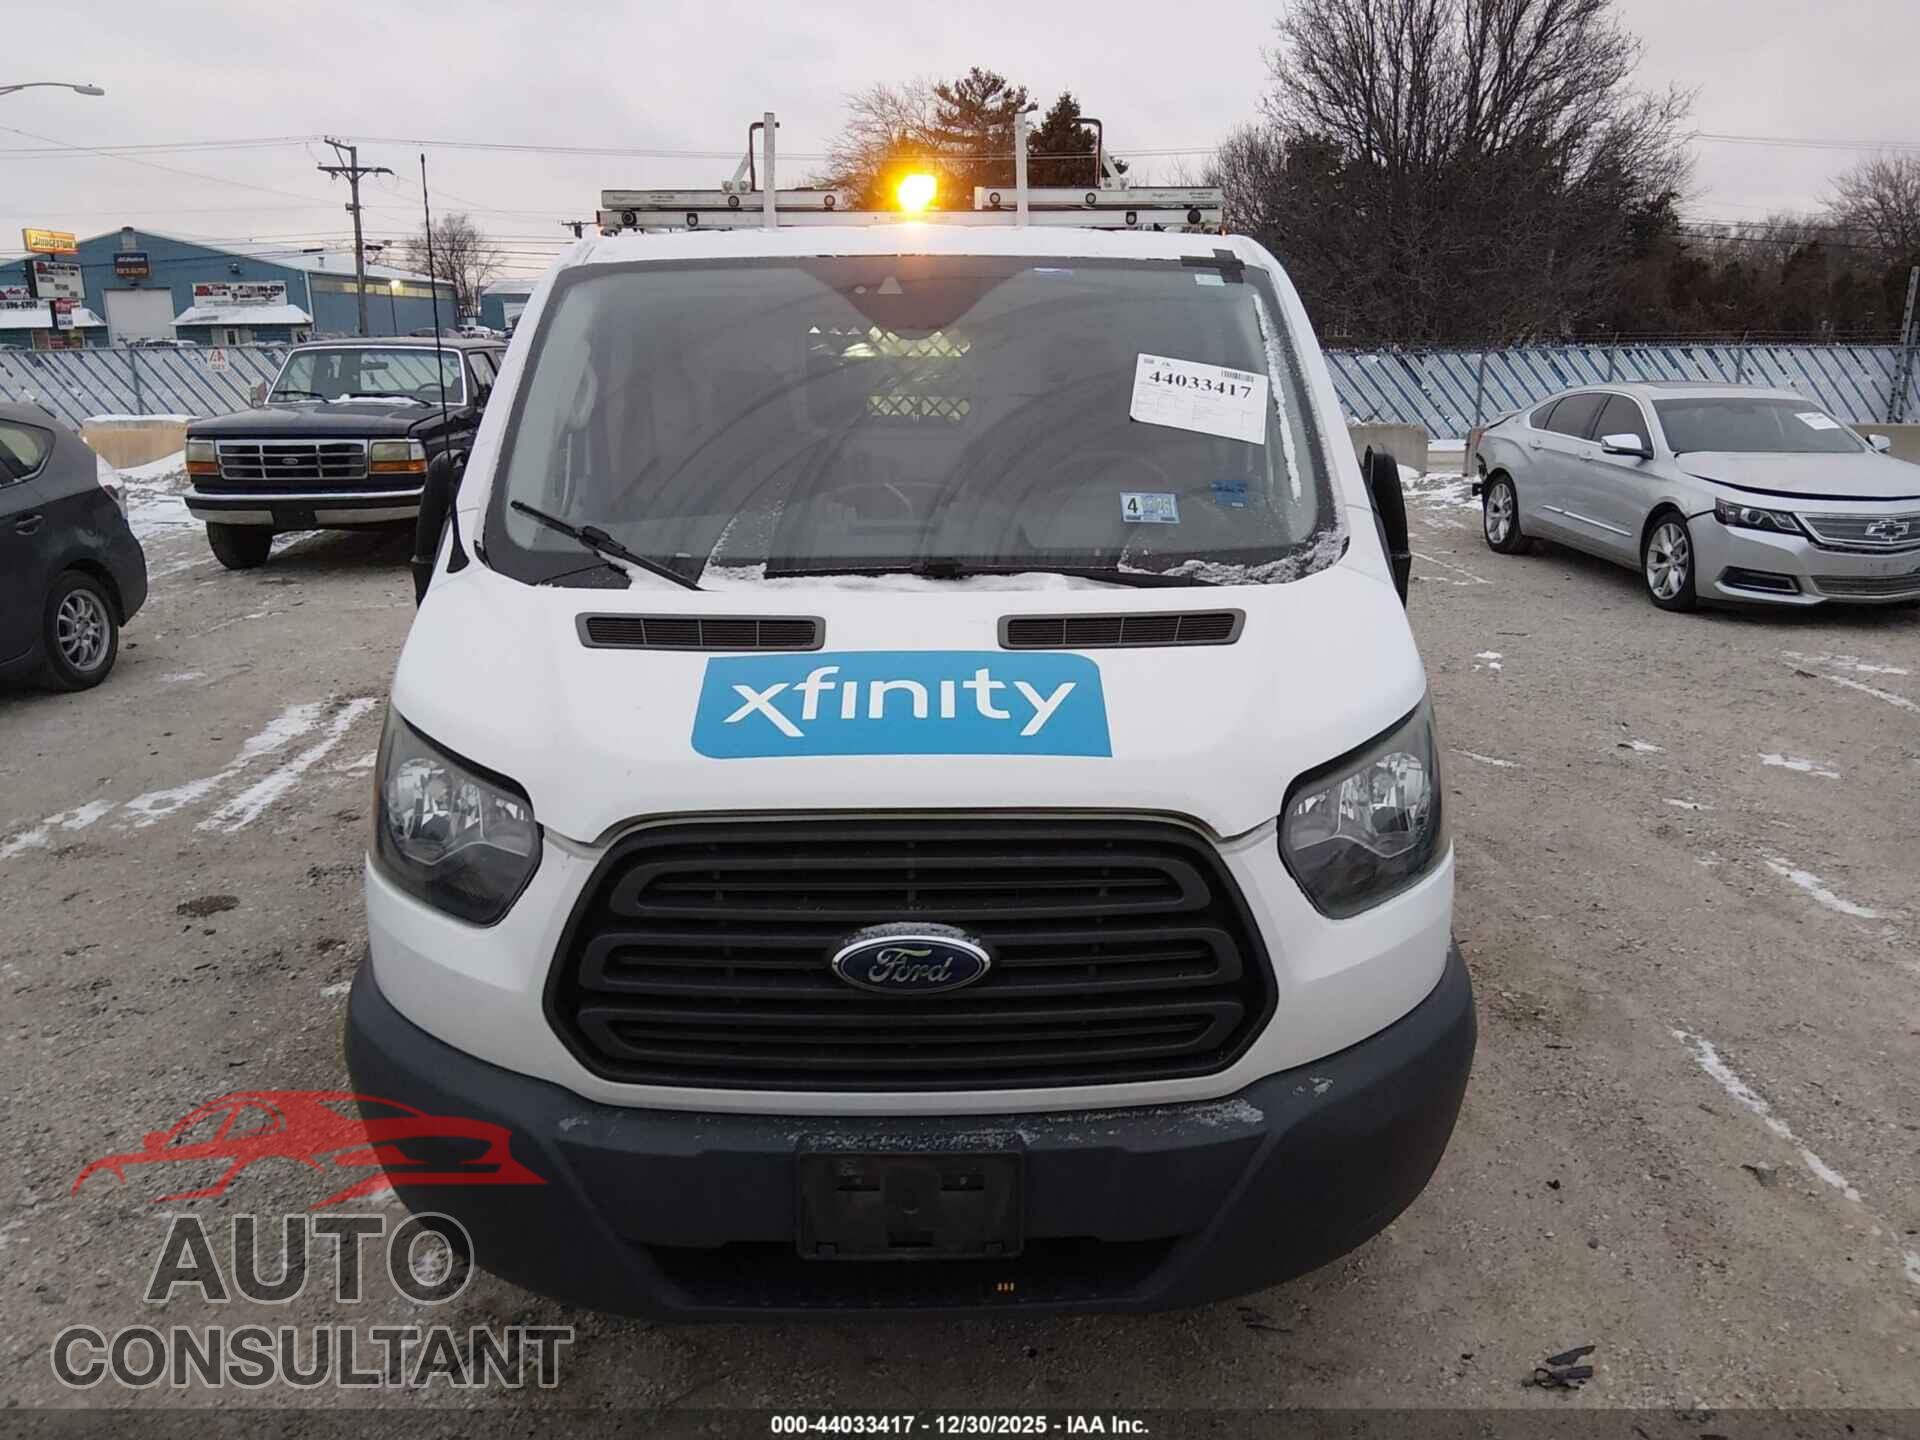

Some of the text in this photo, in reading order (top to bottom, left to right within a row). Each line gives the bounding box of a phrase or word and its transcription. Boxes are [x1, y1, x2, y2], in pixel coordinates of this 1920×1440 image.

[1149, 371, 1252, 399] 44033417
[1127, 497, 1138, 513] 4
[723, 666, 1077, 737] xfinity
[868, 948, 954, 982] Ford
